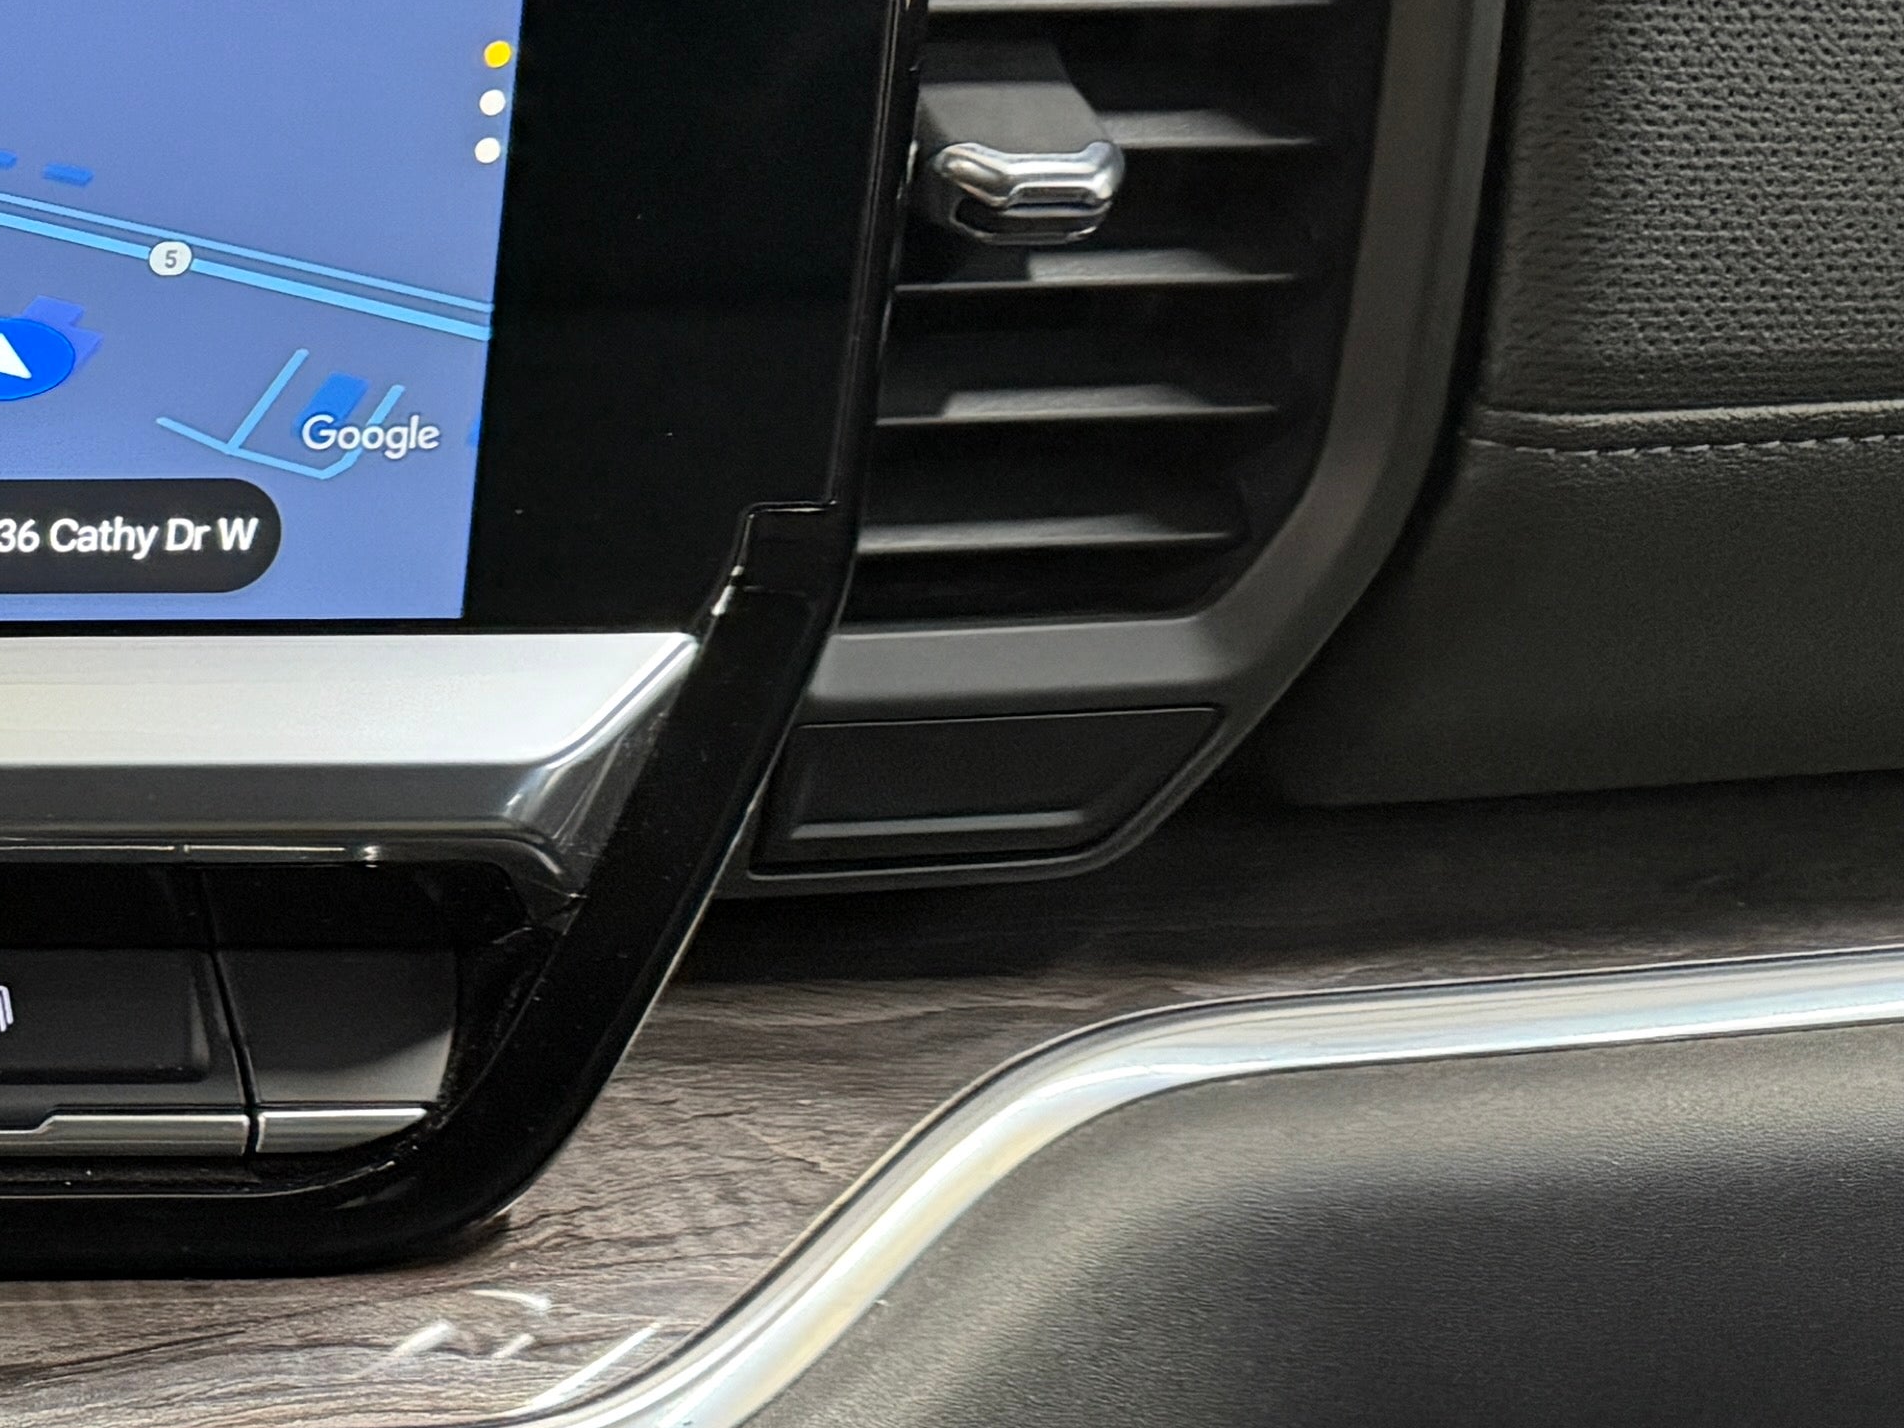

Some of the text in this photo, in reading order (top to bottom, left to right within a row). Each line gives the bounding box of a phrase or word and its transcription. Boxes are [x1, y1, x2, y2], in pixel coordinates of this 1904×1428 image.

[164, 250, 178, 269] 5
[300, 414, 441, 460] Google
[48, 515, 160, 563] Cathy
[164, 517, 212, 552] Dr
[216, 516, 260, 552] W
